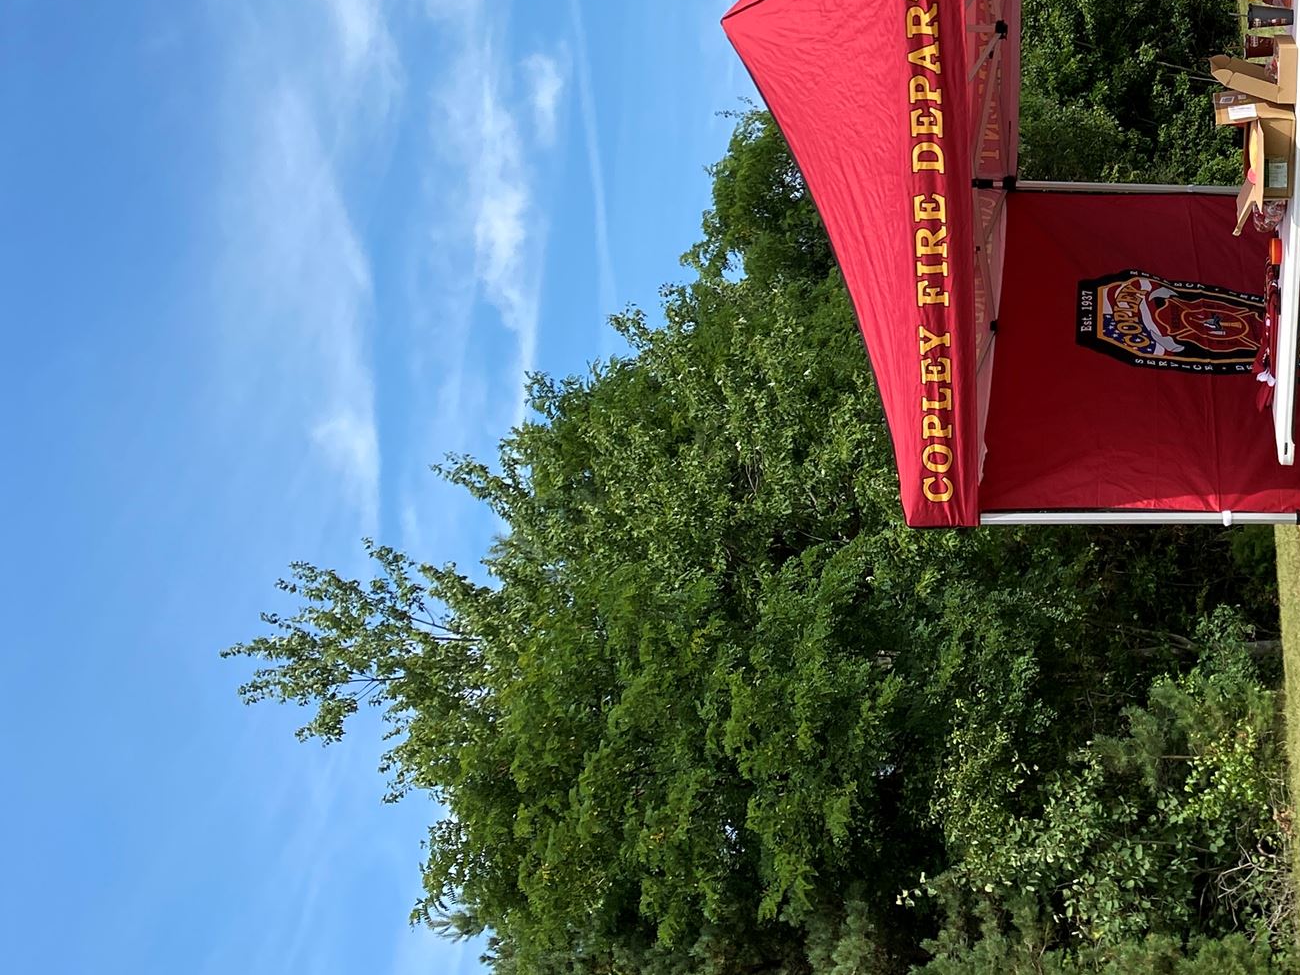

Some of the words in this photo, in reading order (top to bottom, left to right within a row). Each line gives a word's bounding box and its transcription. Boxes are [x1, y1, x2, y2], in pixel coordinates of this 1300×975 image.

[913, 193, 950, 307] FIRE
[1080, 290, 1093, 311] 1937
[1113, 281, 1150, 348] COPLEY
[1080, 314, 1093, 332] Est.
[1134, 358, 1213, 371] SERVICE
[918, 326, 954, 503] COPLEY
